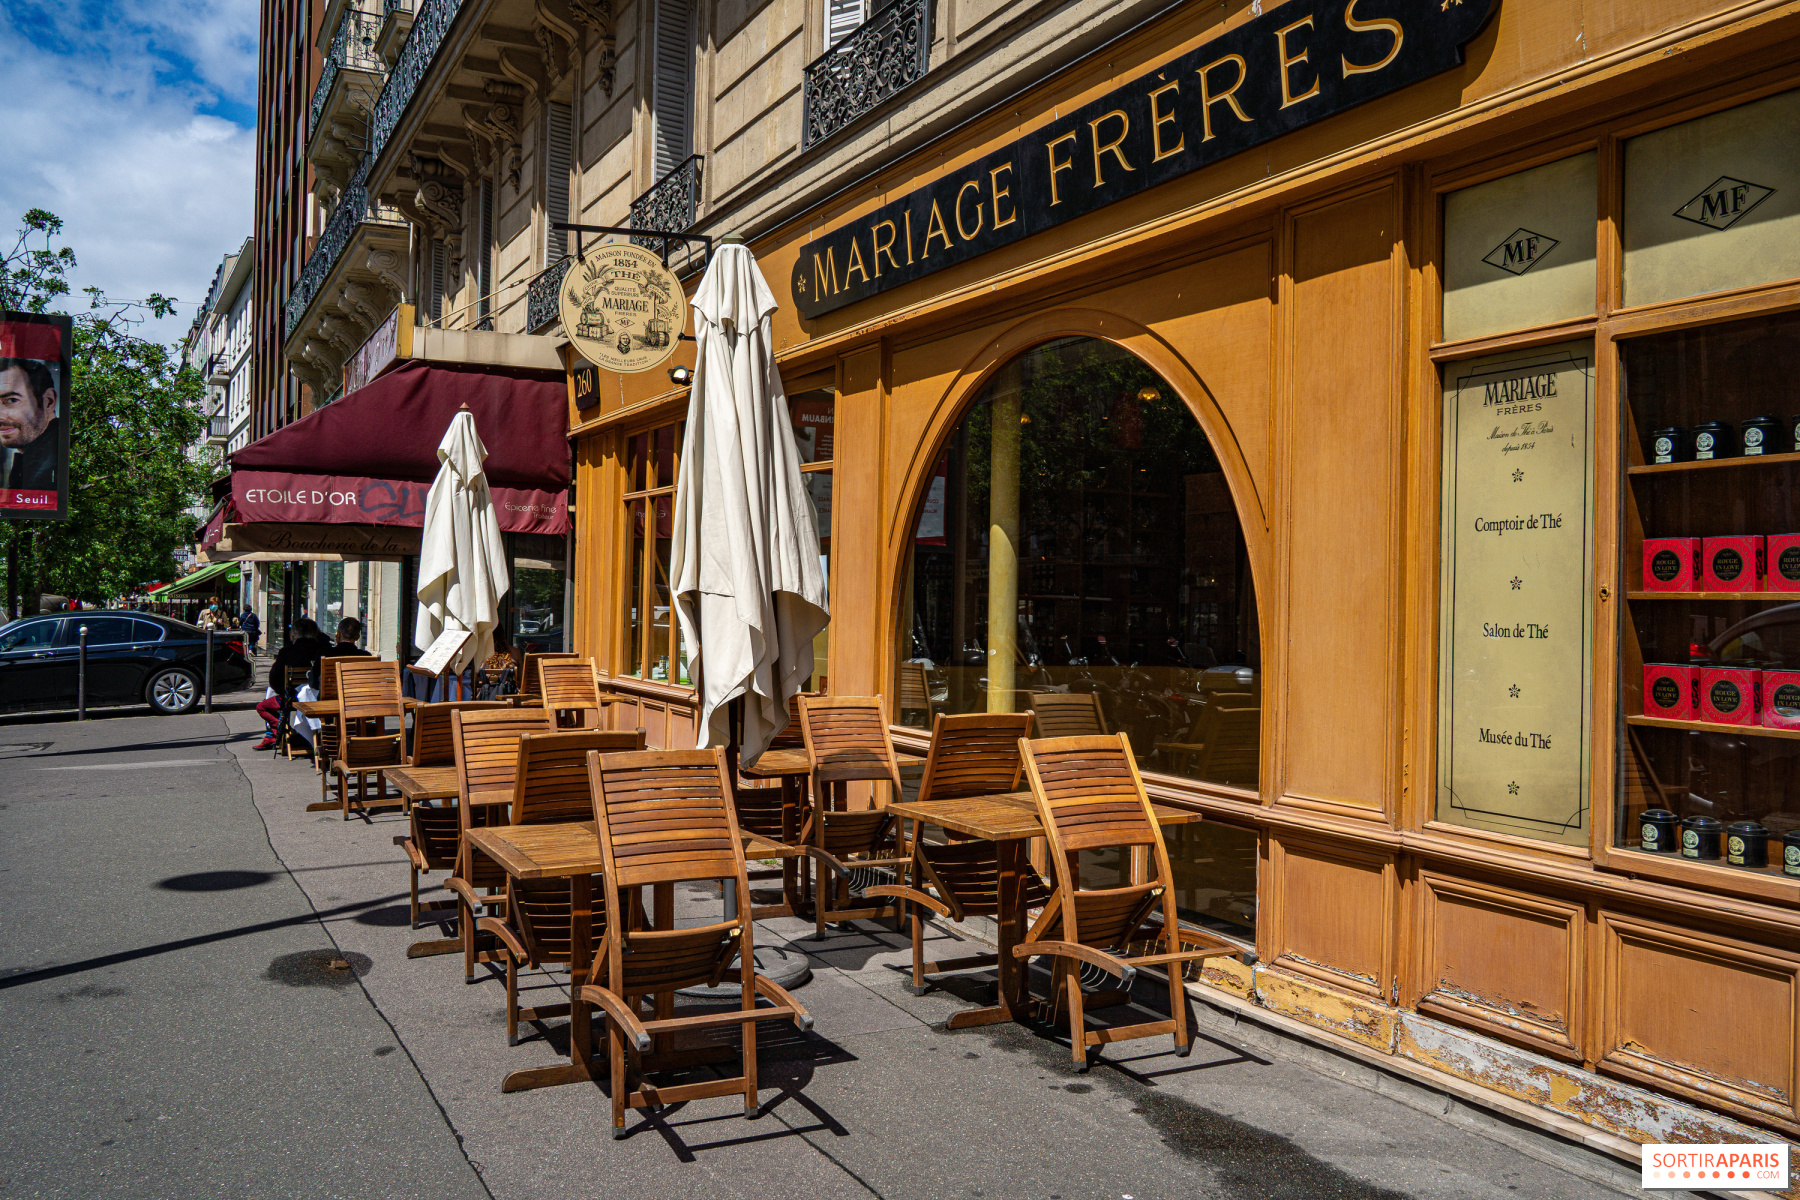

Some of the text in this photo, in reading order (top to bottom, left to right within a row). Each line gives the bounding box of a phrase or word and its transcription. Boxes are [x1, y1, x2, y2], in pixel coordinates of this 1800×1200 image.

[813, 0, 1405, 303] MARIAGE FRÈRES
[1699, 184, 1750, 223] MF
[595, 250, 622, 262] MAISON
[646, 260, 657, 268] EN
[1502, 235, 1540, 268] MF
[612, 258, 638, 269] 1854
[601, 297, 649, 313] MARIAGE
[576, 368, 592, 398] 260
[1482, 372, 1558, 408] MARIAGE
[1496, 402, 1542, 416] FRÈRES
[1501, 441, 1536, 456] depuis 1854
[16, 493, 48, 505] Seuil
[245, 488, 357, 506] ETOILE D'OR
[540, 503, 557, 514] fine
[1474, 513, 1562, 536] Comptoir de Thé
[267, 530, 359, 553] Boucherie
[360, 536, 378, 552] de
[382, 536, 398, 553] la
[1482, 622, 1549, 639] Salon de Thé
[1479, 727, 1552, 750] Musée du Thé
